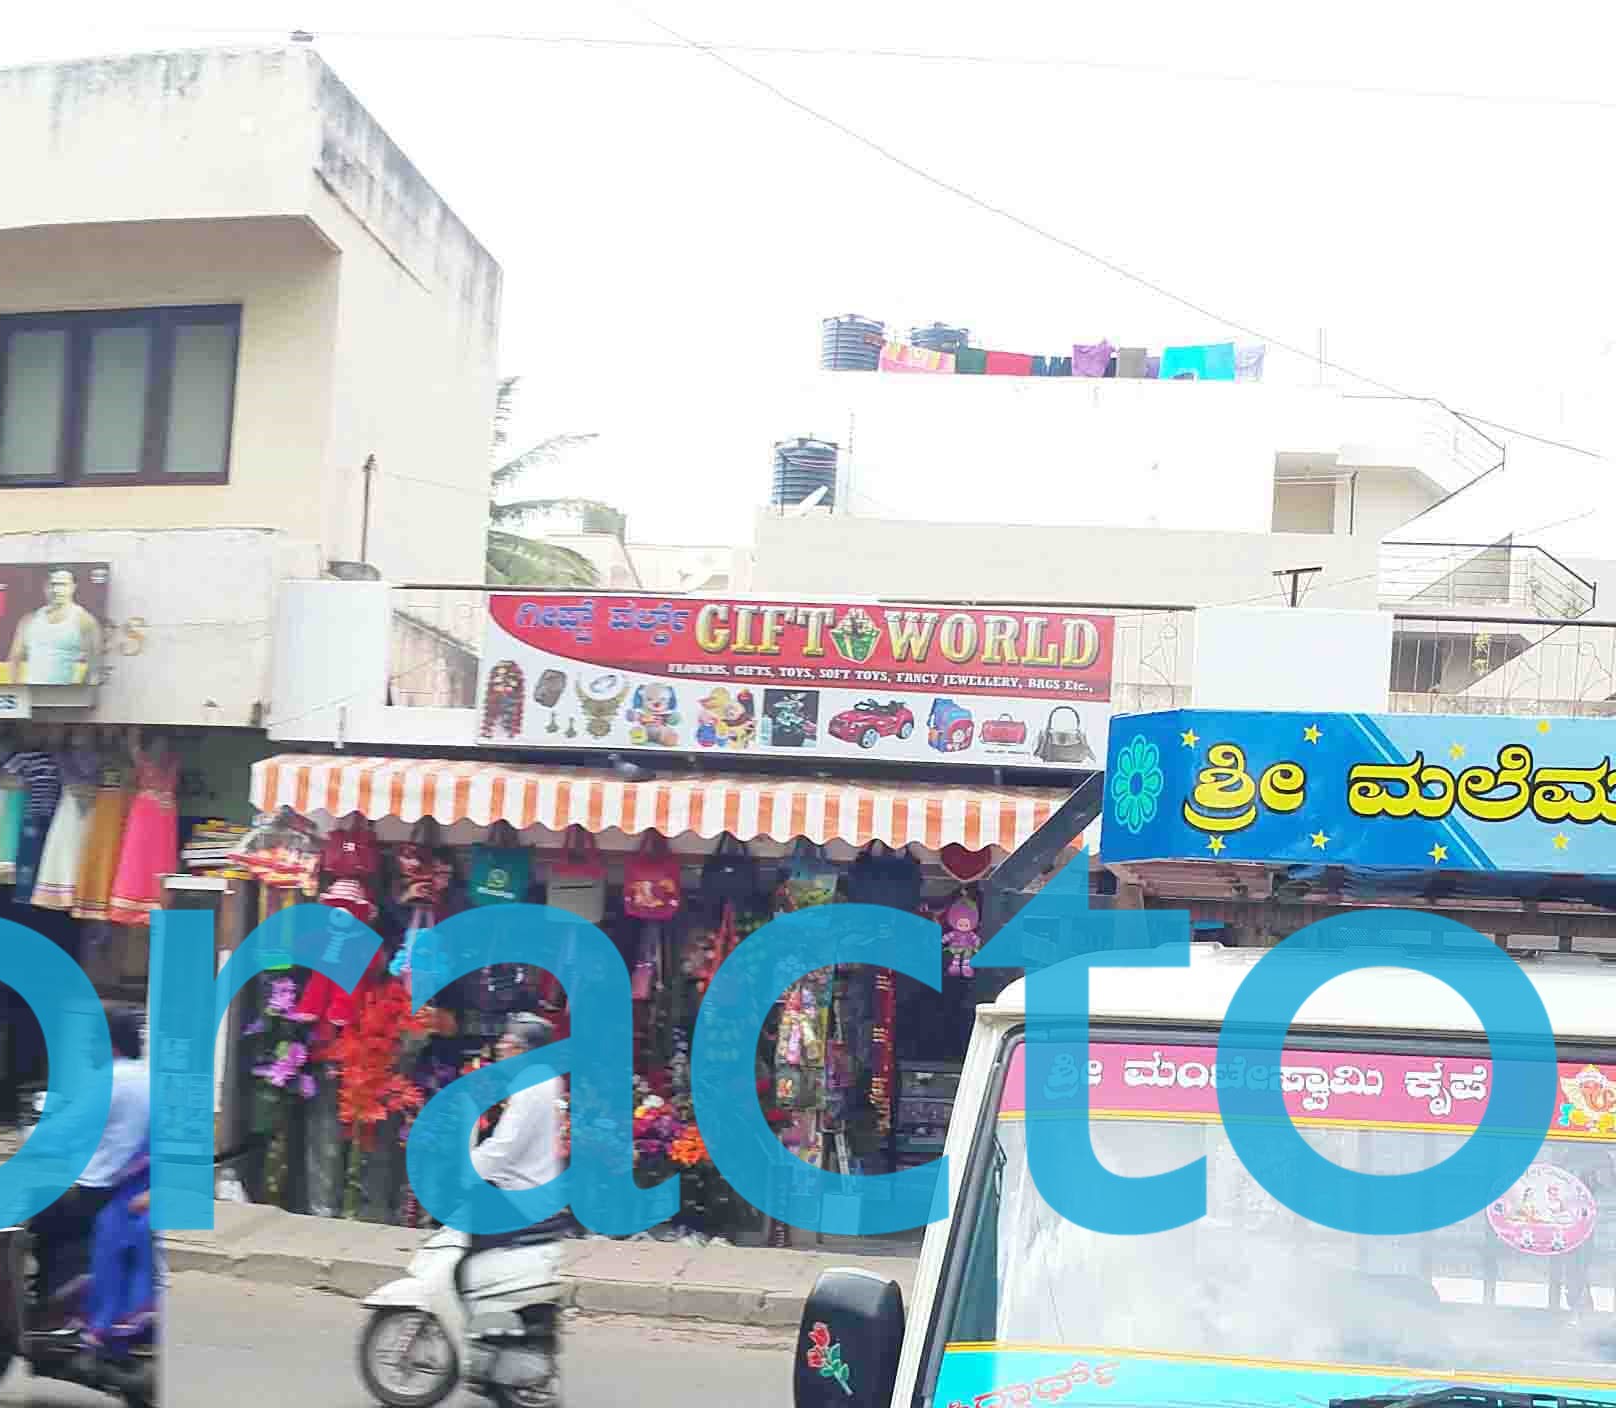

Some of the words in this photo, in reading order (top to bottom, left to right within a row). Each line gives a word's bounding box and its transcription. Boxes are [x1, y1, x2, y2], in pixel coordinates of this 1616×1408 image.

[695, 603, 834, 655] GIFT
[883, 609, 1101, 668] WORLD
[779, 667, 815, 681] TOYS,
[819, 668, 851, 681] SOFT
[855, 669, 891, 684] TOYS,
[896, 671, 939, 685] FANCY
[1183, 743, 1307, 832] ಶ್ರೀ
[1043, 1052, 1103, 1099] ಶ್ರೀ
[1405, 1060, 1488, 1116] ಕೃಪೆ
